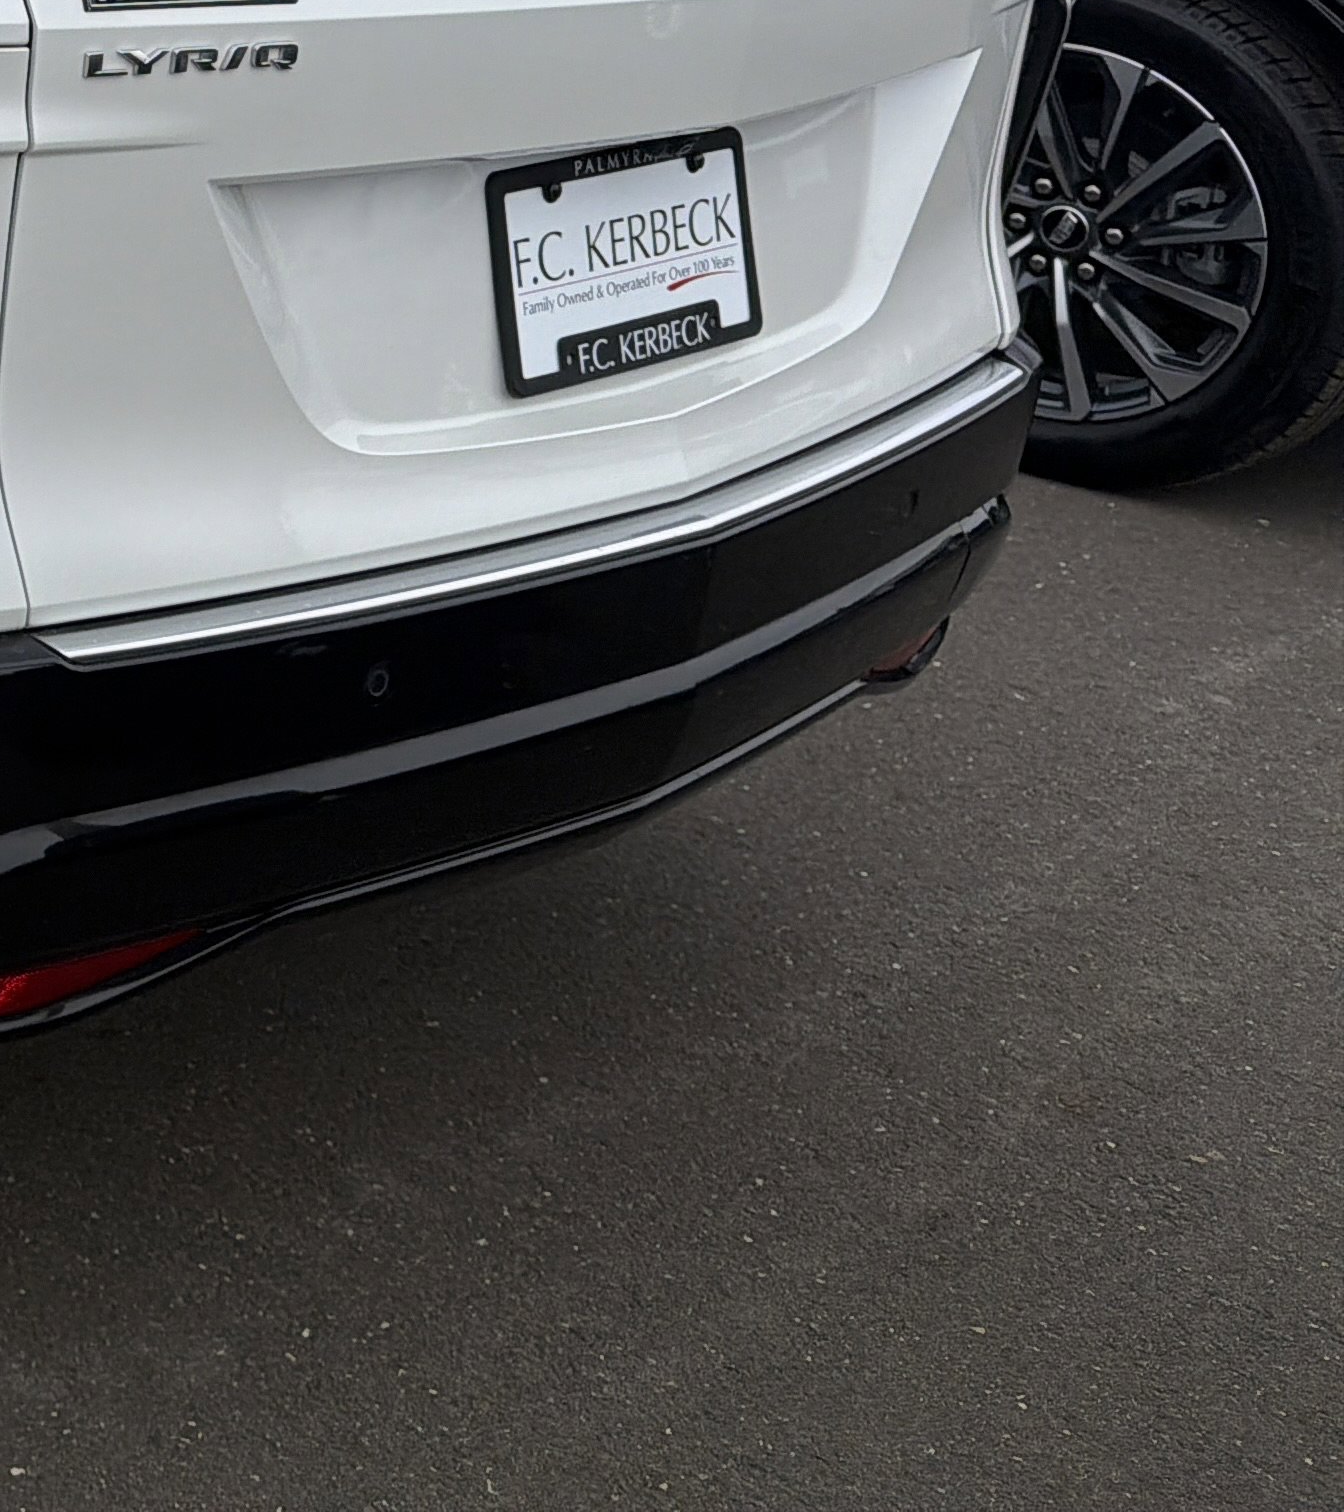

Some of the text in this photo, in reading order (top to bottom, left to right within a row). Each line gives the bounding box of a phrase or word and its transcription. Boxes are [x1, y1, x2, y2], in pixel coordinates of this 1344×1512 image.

[513, 193, 736, 288] F.C. KERBECK
[522, 255, 735, 316] Family Owned & Operated For Over 100 Years
[577, 312, 712, 375] F.C. KERBECK
